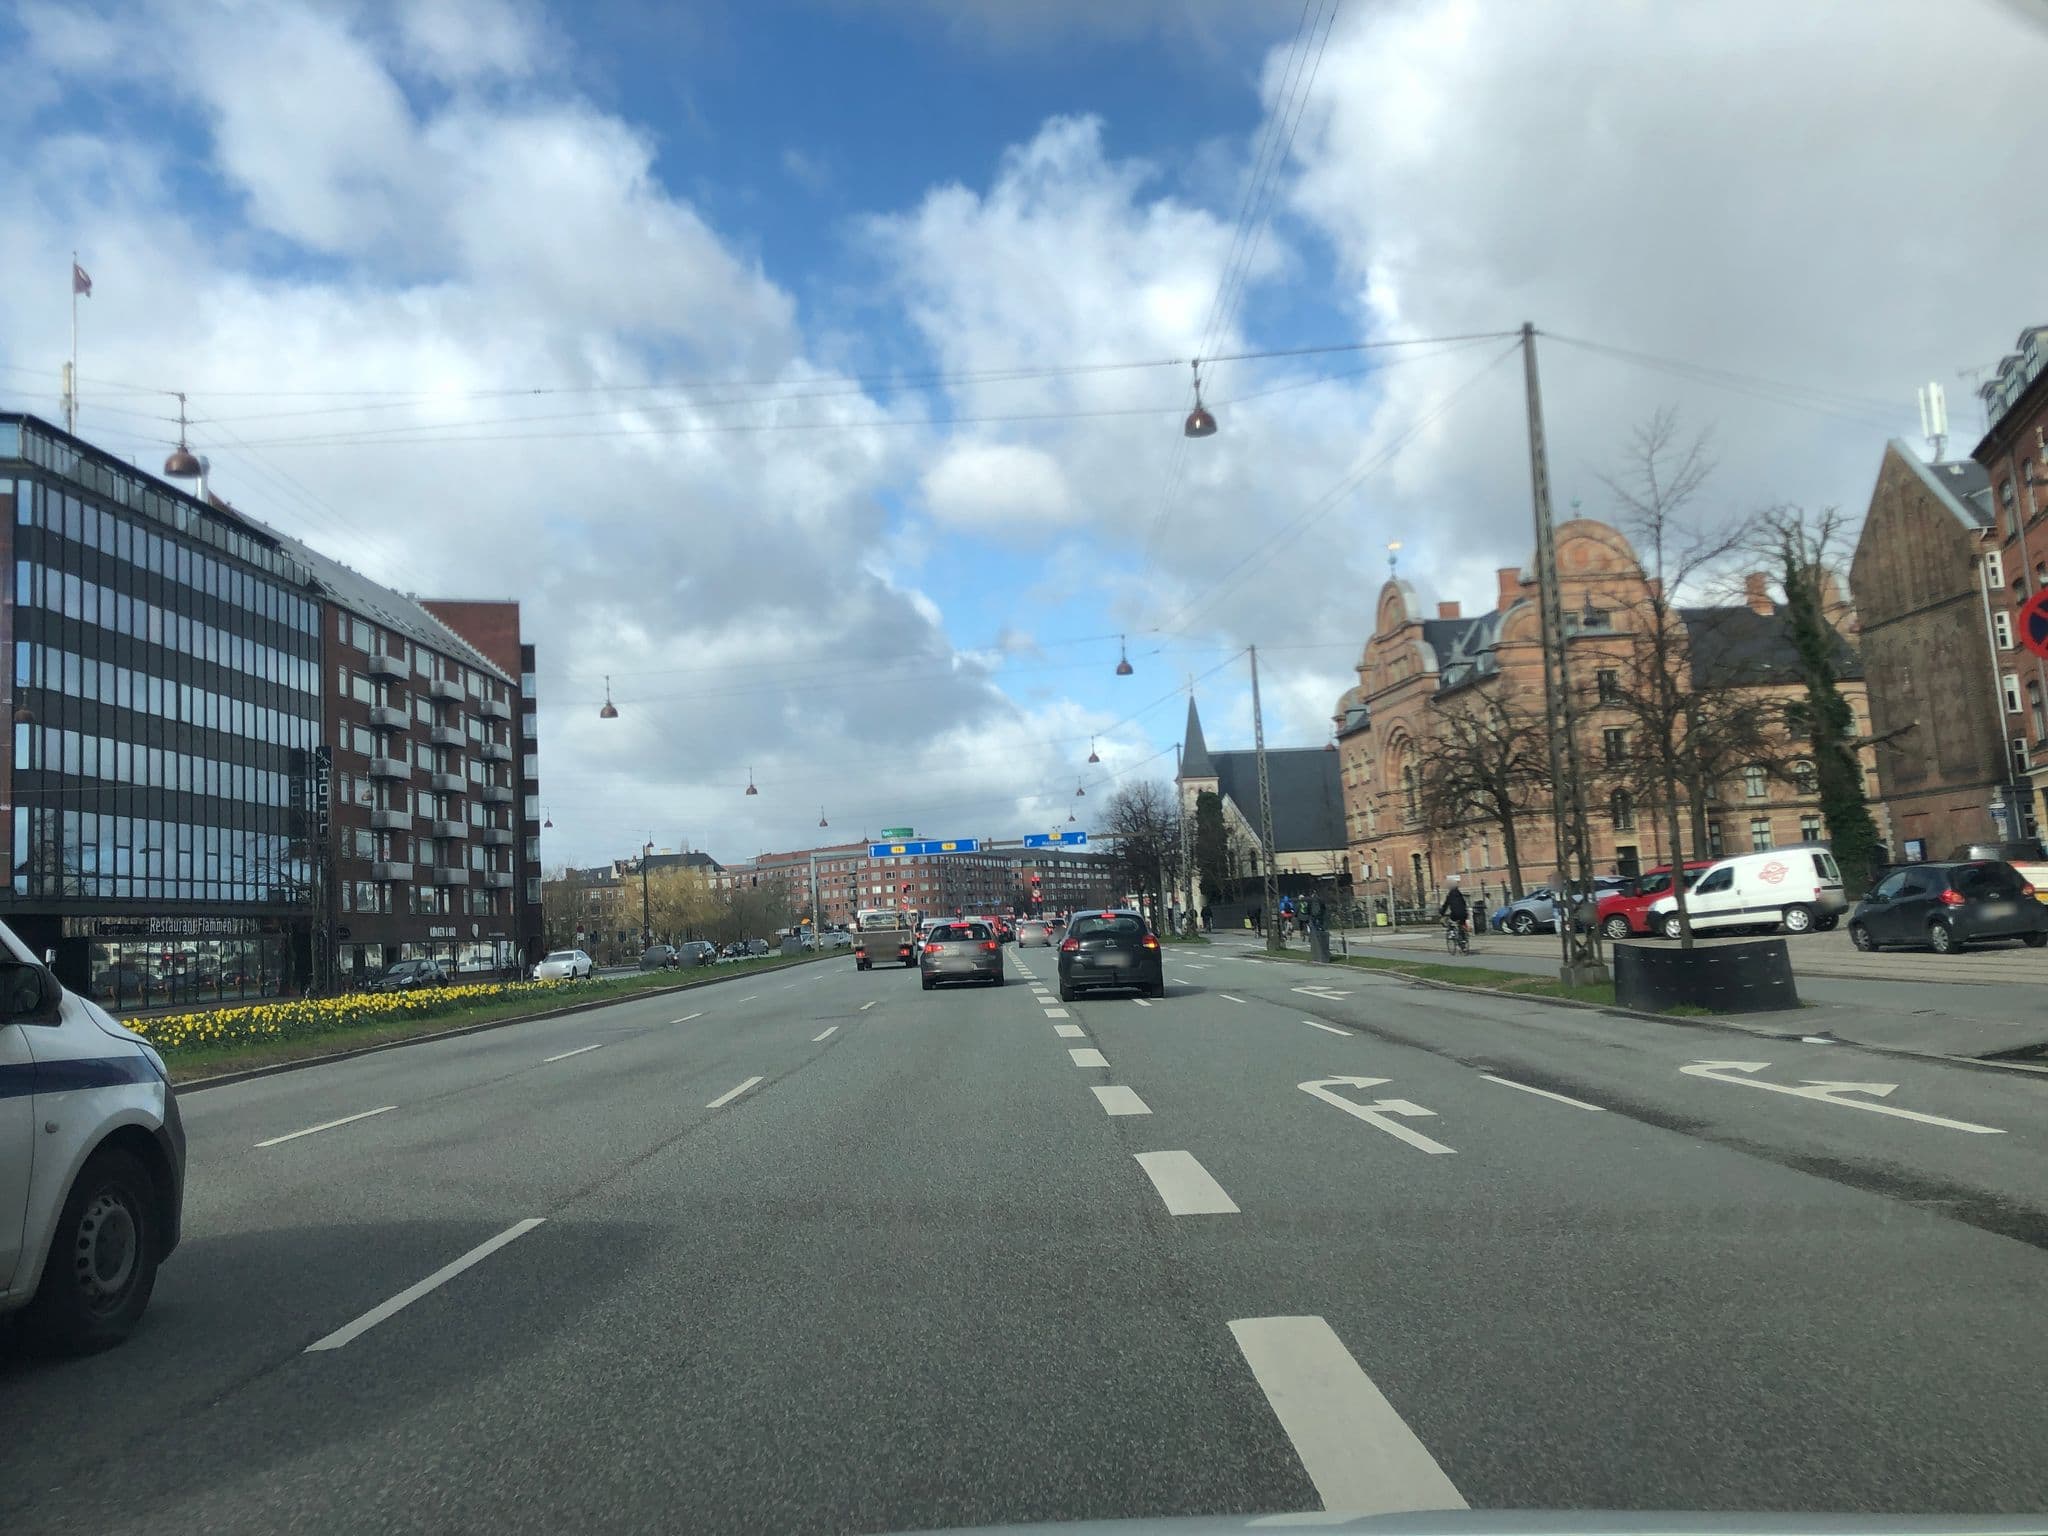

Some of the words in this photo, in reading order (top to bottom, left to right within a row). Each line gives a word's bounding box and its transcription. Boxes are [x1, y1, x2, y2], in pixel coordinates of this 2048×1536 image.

[318, 767, 329, 833] HOTEL
[149, 917, 197, 933] Restaurant
[198, 917, 232, 932] Flammen
